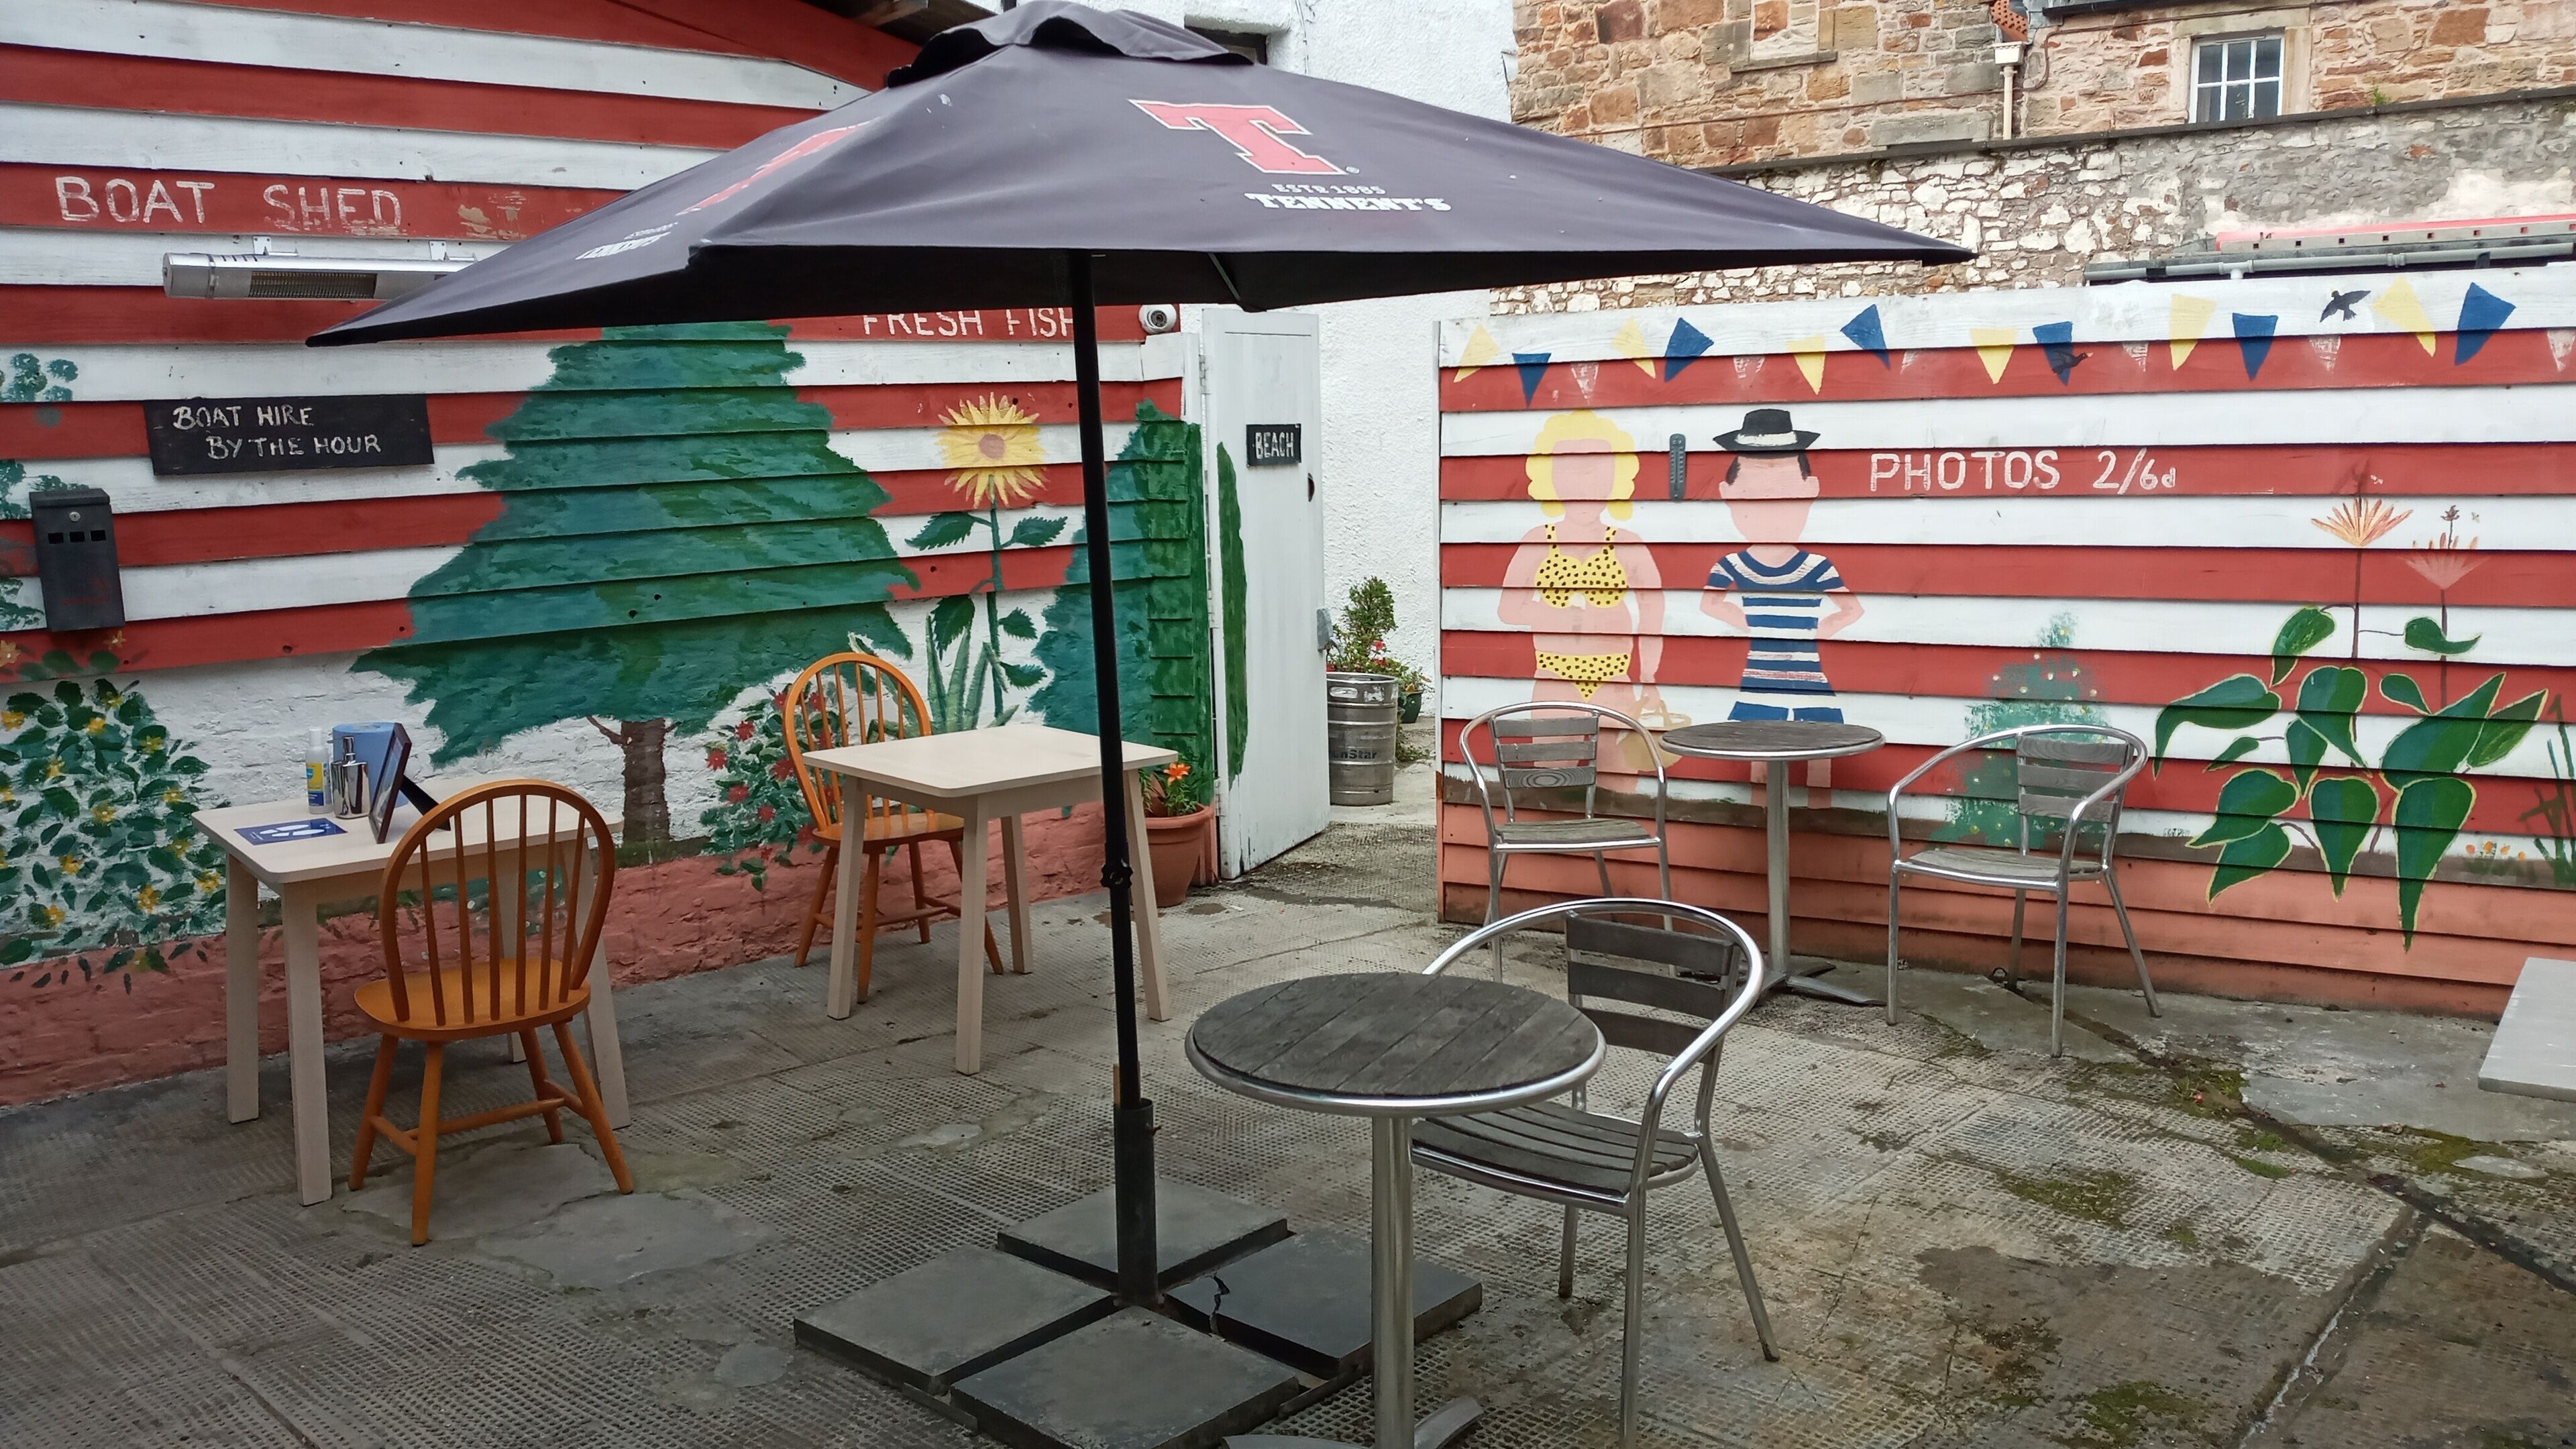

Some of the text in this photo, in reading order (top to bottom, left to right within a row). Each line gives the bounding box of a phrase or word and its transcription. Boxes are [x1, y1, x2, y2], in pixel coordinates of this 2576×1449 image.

[1127, 99, 1347, 175] T
[1244, 193, 1452, 211] TENNENT'S
[1330, 185, 1386, 195] 1885
[55, 176, 402, 231] BOAT SHED
[863, 310, 983, 336] FRESH
[172, 404, 314, 430] BOAT HIRE
[206, 434, 381, 460] BY THE HOUR
[1254, 431, 1294, 459] BEACH
[1870, 447, 2176, 495] PHOTOS 2/6d
